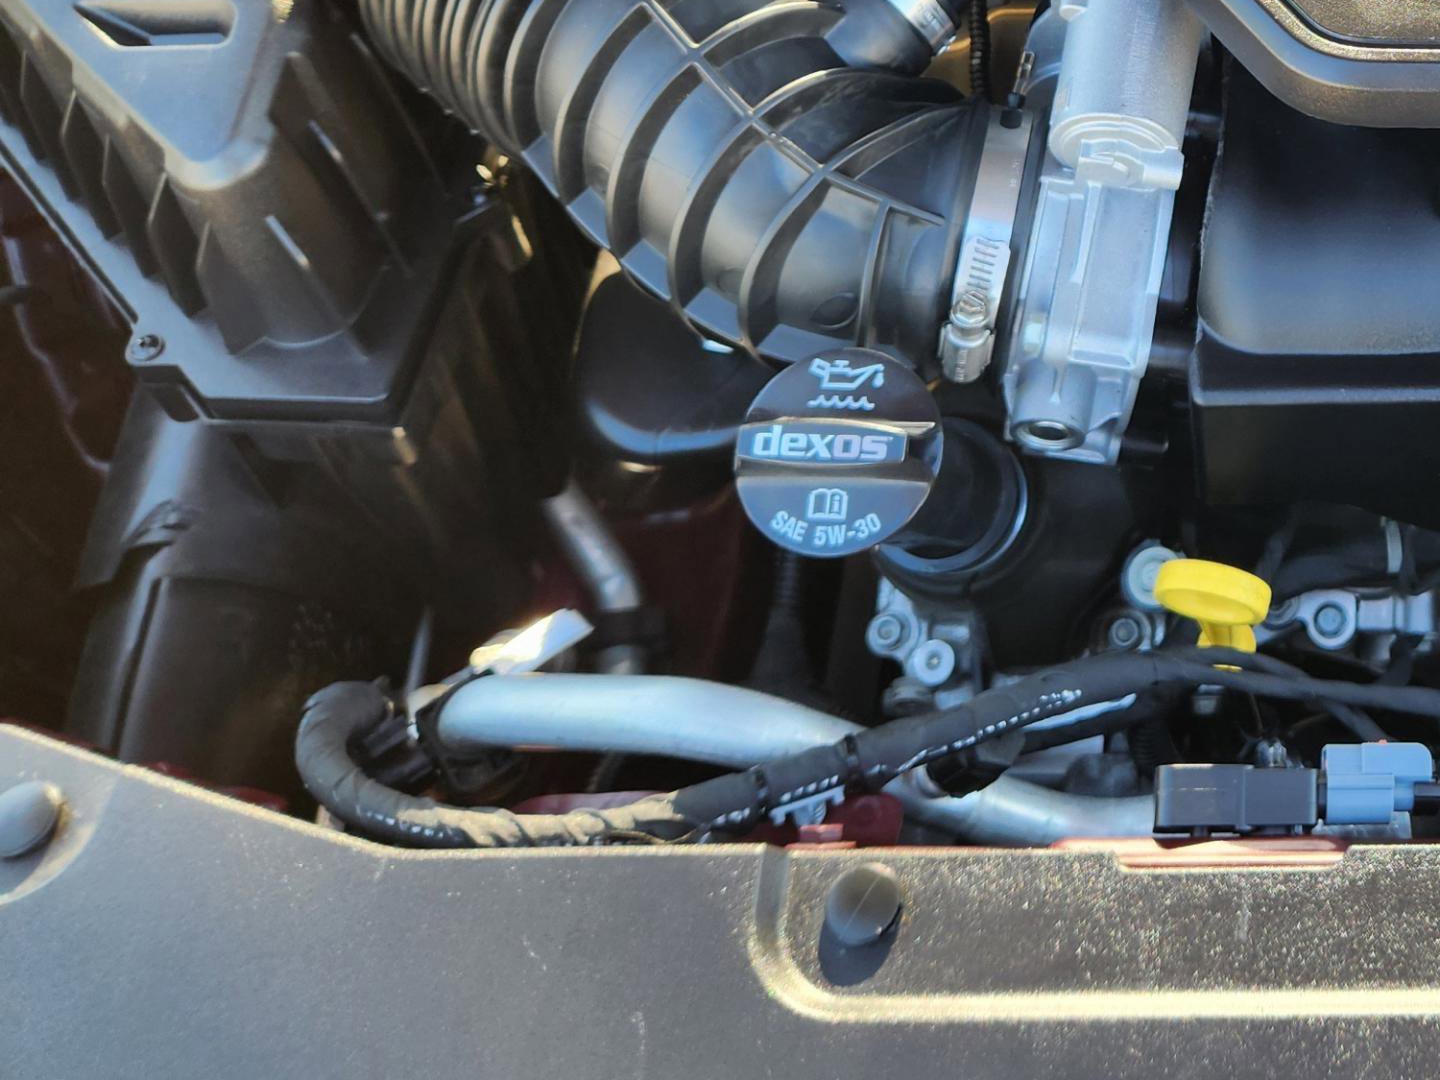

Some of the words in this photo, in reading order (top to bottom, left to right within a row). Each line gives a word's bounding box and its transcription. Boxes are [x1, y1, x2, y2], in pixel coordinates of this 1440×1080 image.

[753, 424, 889, 461] dexos
[771, 510, 809, 542] SAE
[813, 513, 882, 547] 5W-30
